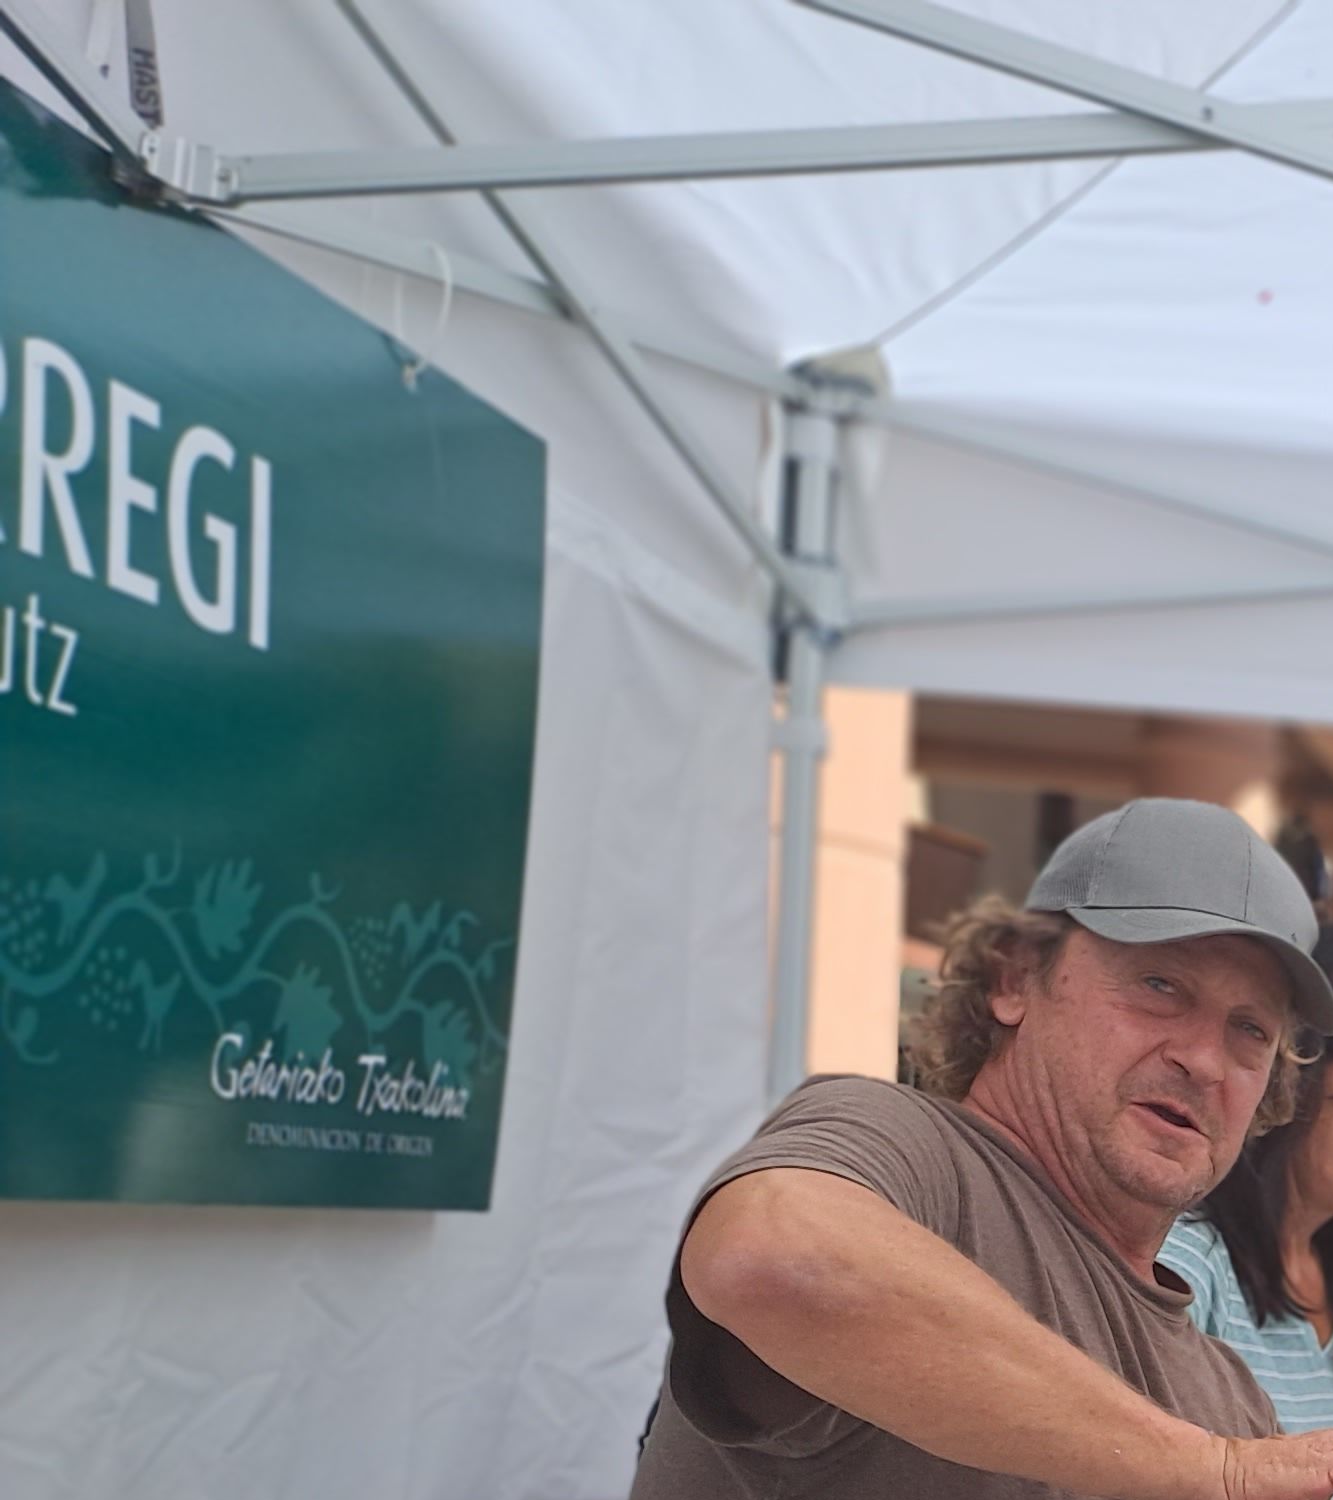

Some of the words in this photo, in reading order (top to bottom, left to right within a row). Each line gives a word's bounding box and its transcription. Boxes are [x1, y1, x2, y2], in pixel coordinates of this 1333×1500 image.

[0, 336, 272, 651] REGI
[210, 1032, 346, 1105] Getariako
[356, 1054, 471, 1120] Txakolina
